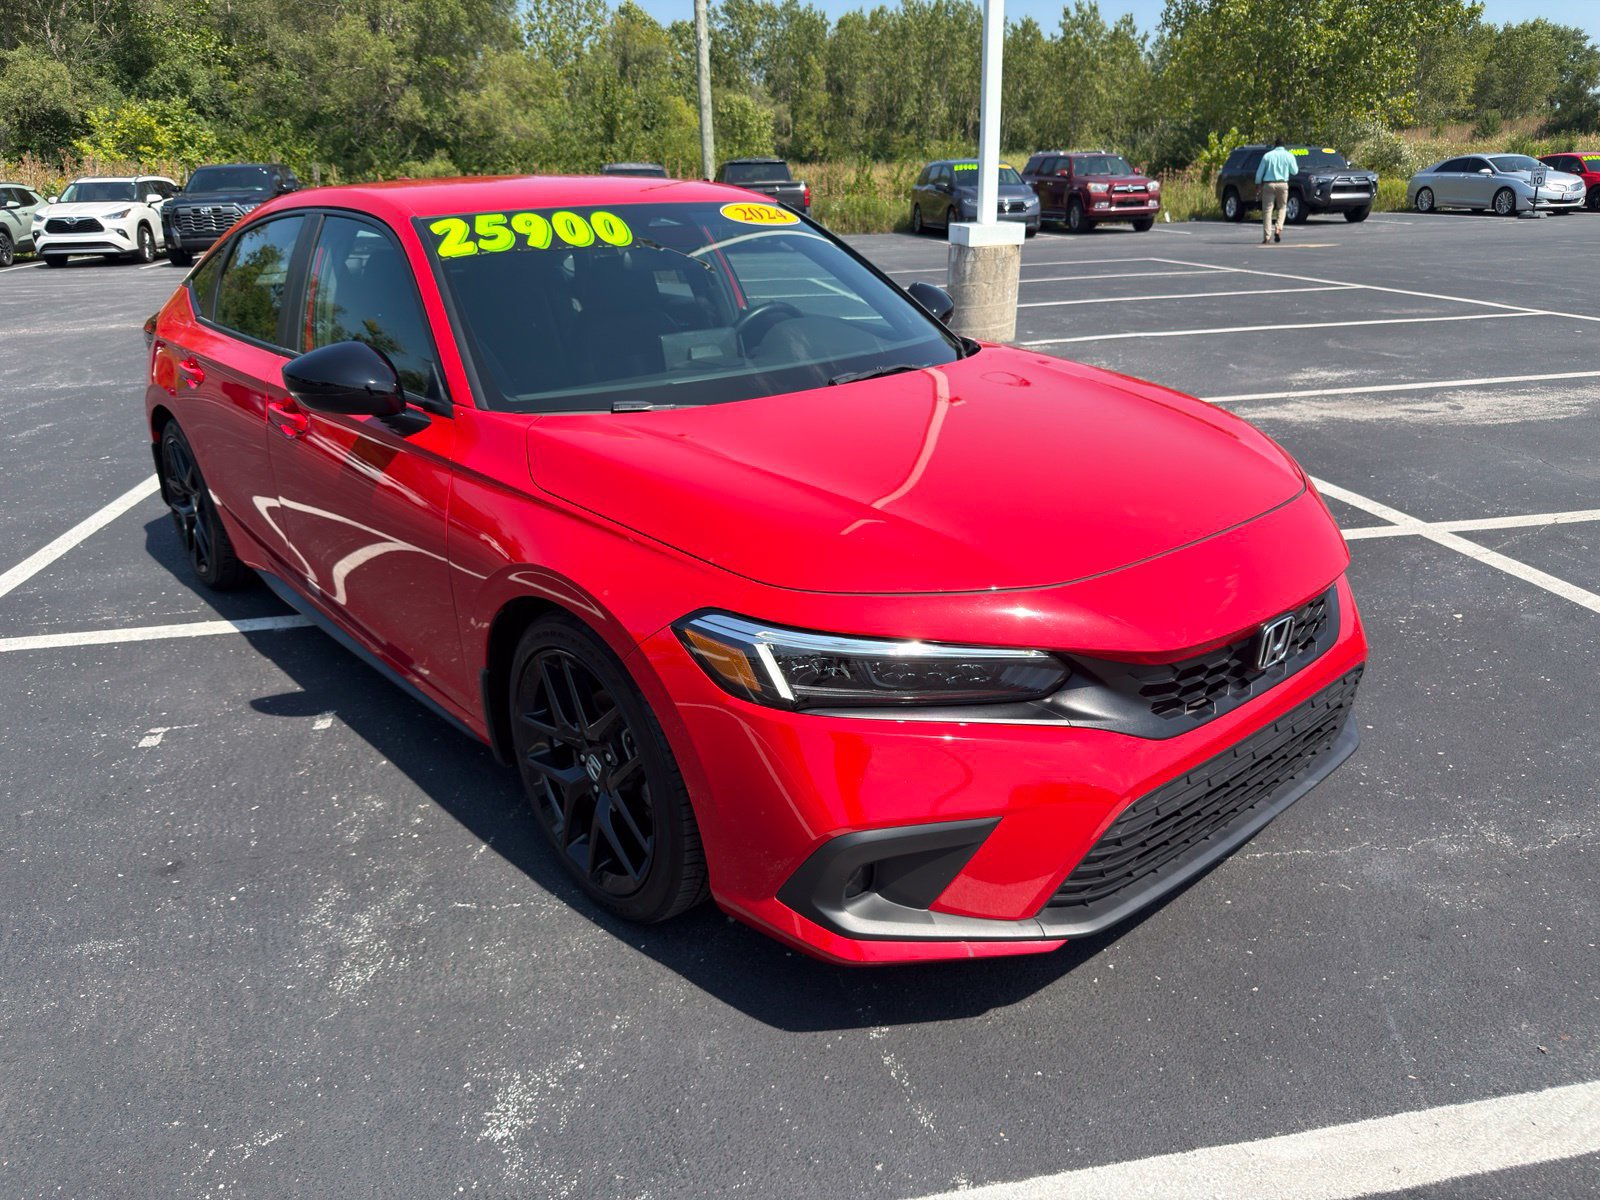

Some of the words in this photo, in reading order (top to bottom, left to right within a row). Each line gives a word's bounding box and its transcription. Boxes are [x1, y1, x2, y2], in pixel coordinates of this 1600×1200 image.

[1533, 176, 1543, 185] 10
[735, 207, 787, 221] 2024
[429, 210, 633, 258] 25900
